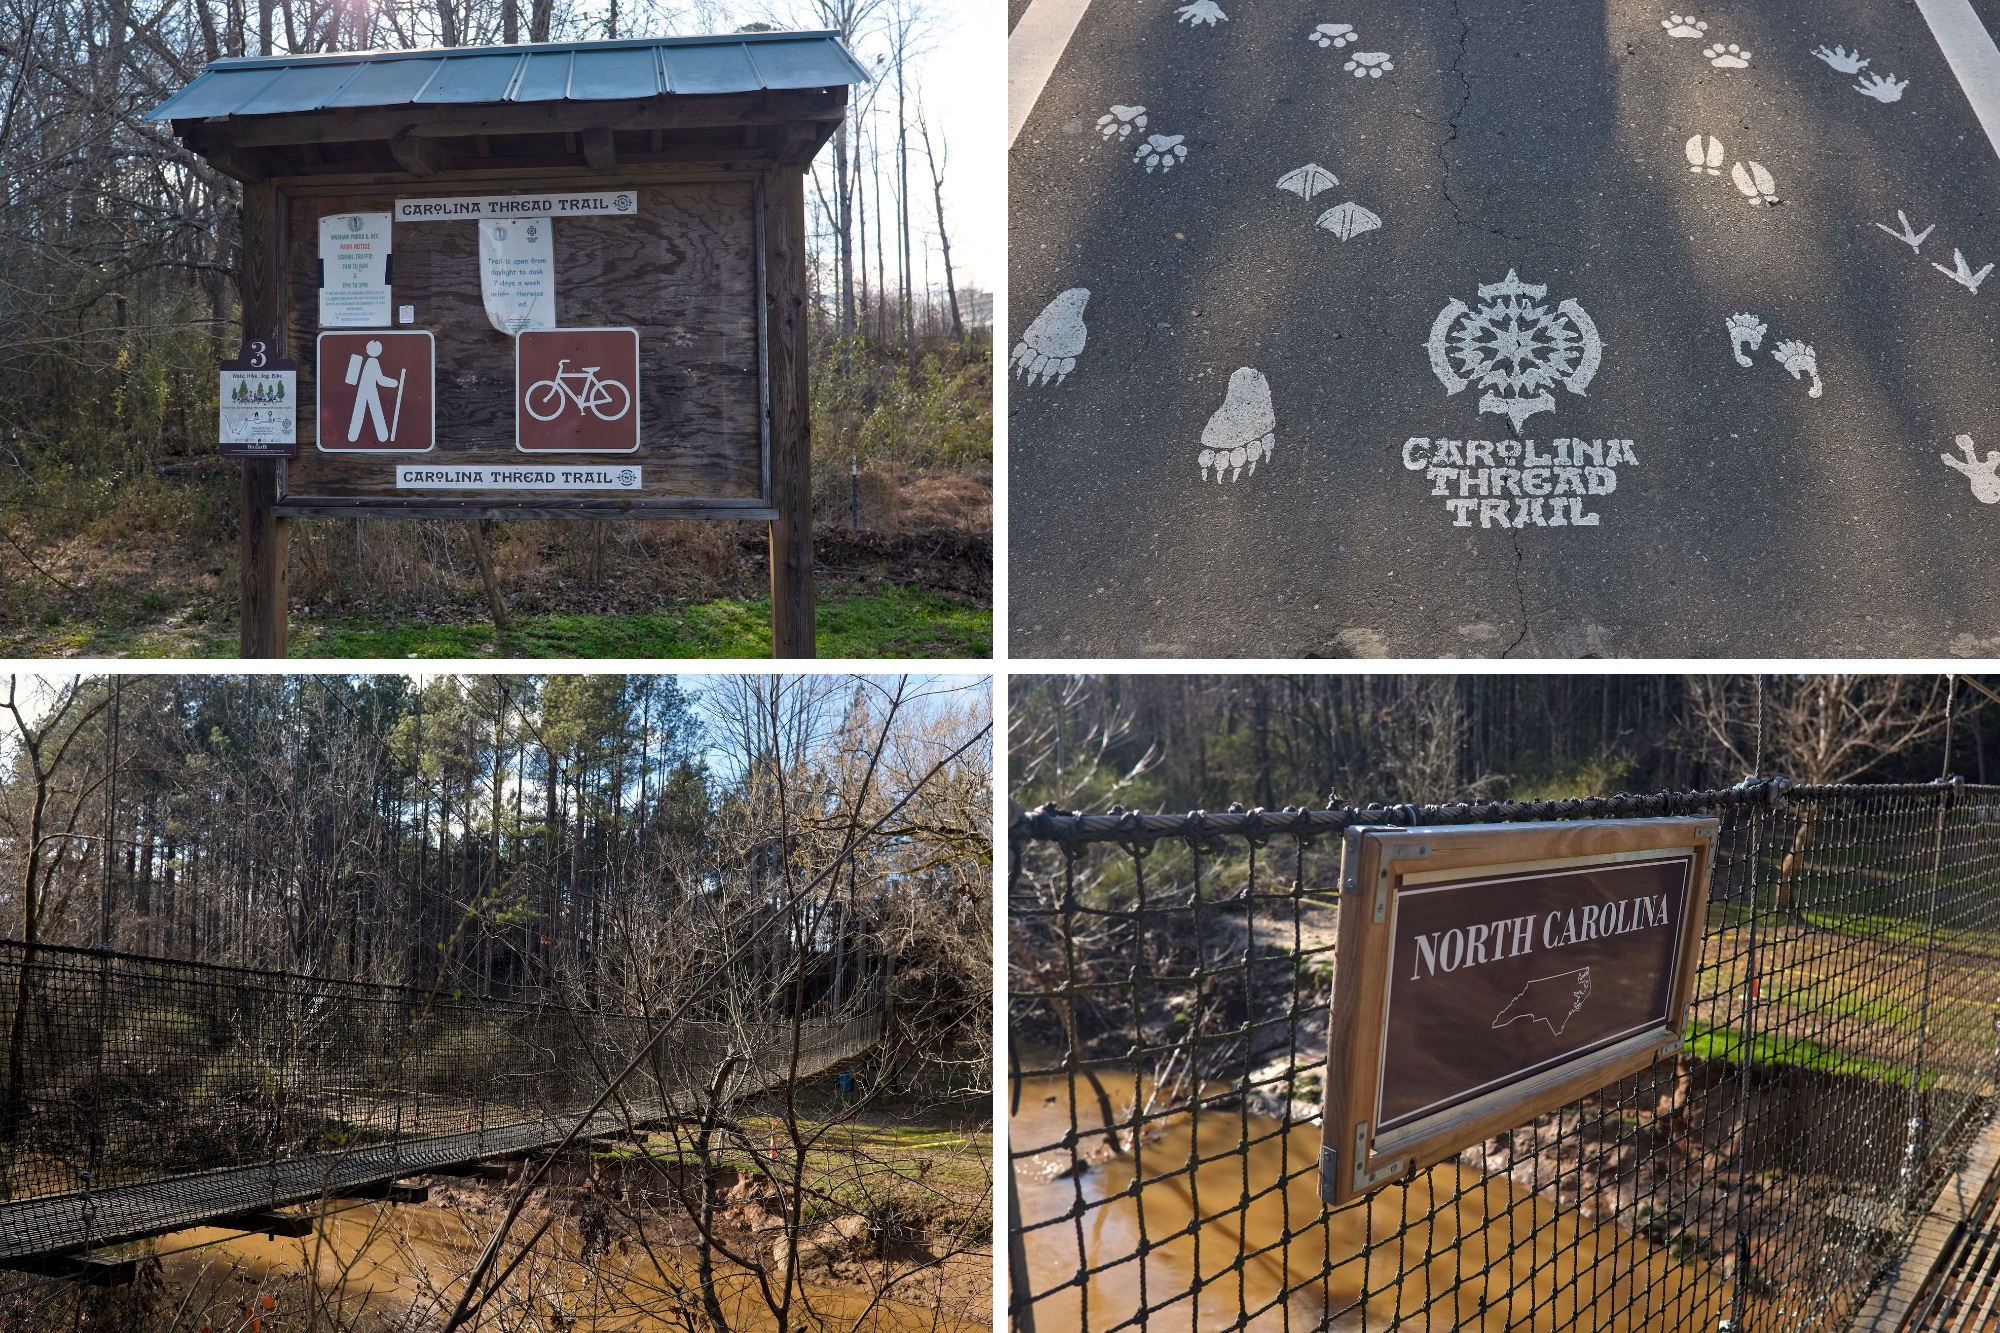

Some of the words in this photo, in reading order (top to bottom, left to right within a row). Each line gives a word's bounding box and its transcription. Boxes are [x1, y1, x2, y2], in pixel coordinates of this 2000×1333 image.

[402, 202, 481, 216] CAROLINA
[487, 200, 553, 214] THREAD
[558, 199, 609, 211] TRAIL
[490, 268, 517, 277] daylight
[528, 268, 544, 276] dusk
[513, 258, 529, 266] open
[500, 280, 516, 288] days
[250, 341, 267, 368] 3
[1402, 437, 1640, 470] CAROLINA
[403, 471, 484, 483] CAROLINA
[490, 471, 556, 483] THREAD
[561, 471, 613, 484] TRAIL
[1427, 466, 1618, 496] THREAD
[1445, 497, 1600, 529] TRAIL
[1410, 914, 1538, 981] NORTH
[1543, 892, 1670, 949] CAROLINA
